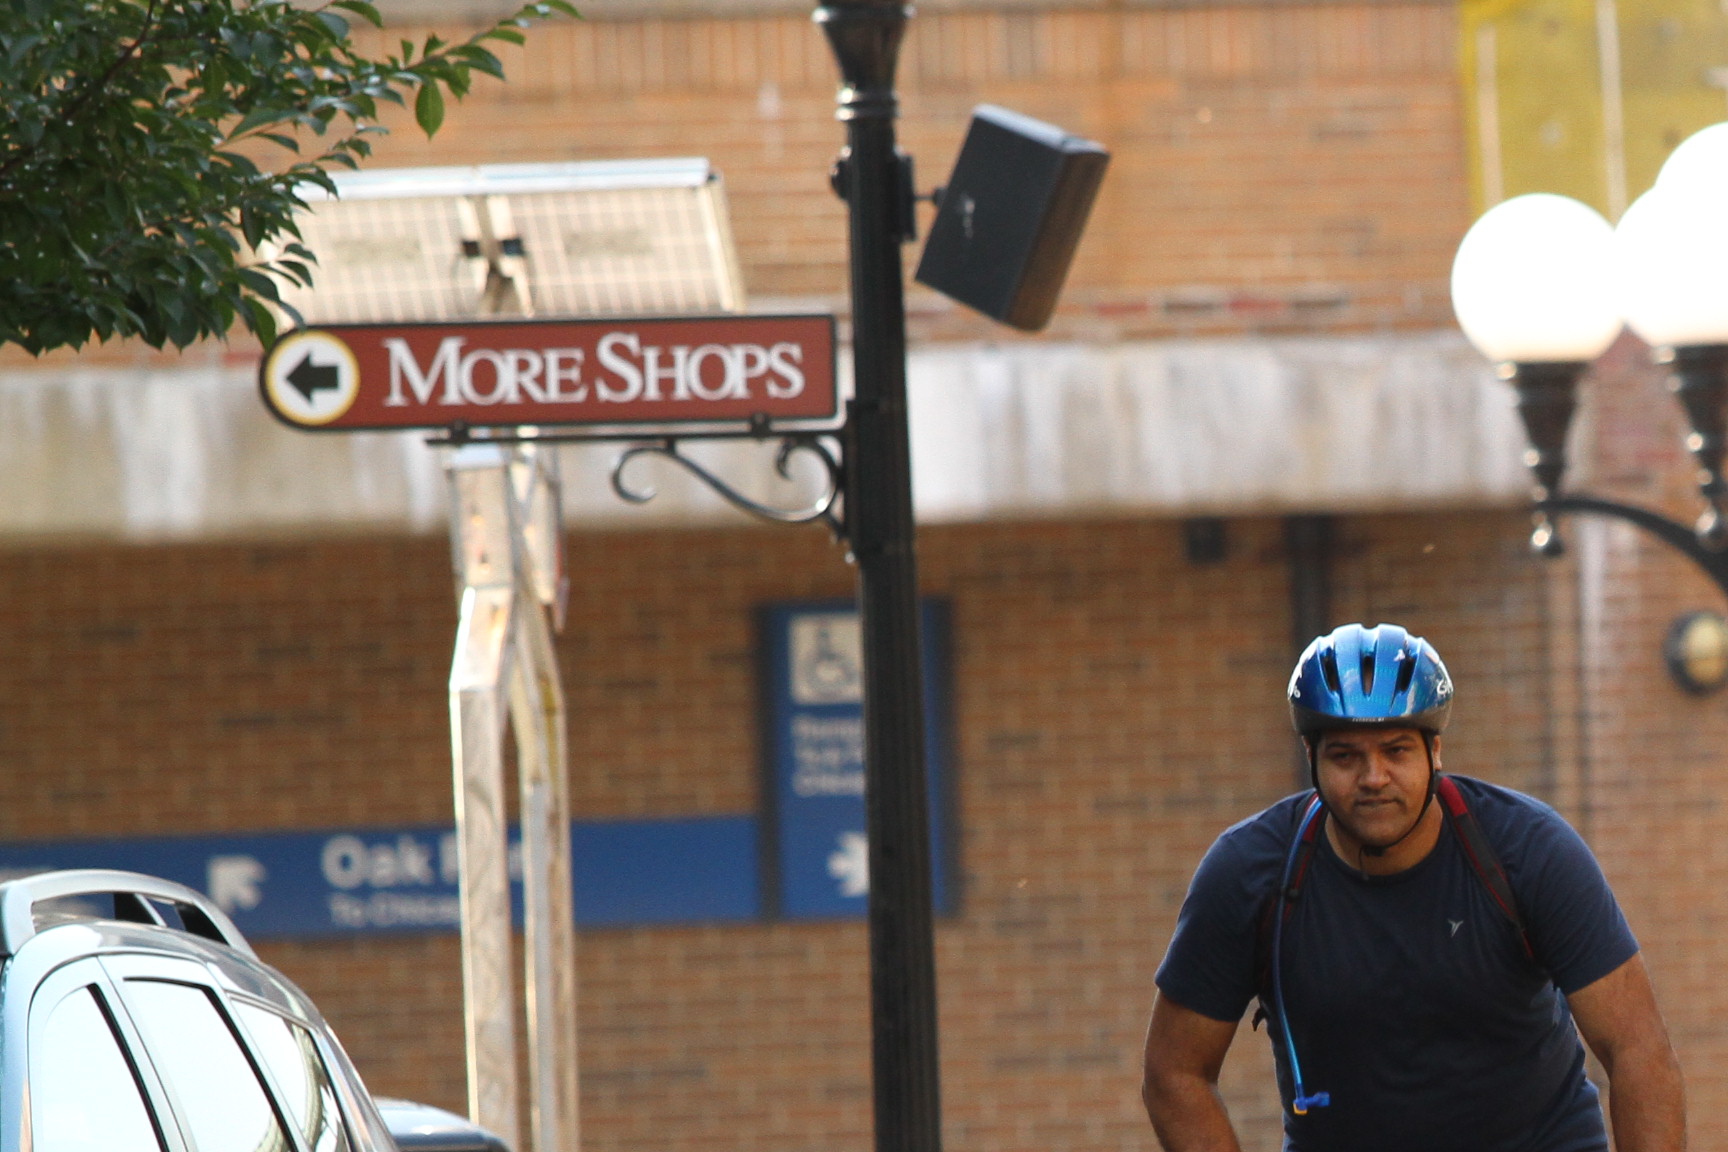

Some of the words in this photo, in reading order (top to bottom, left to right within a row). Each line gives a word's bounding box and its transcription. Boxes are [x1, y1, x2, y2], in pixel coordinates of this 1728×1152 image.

[382, 336, 588, 407] MORE
[596, 332, 805, 402] SHOPS
[321, 834, 436, 888] Oak
